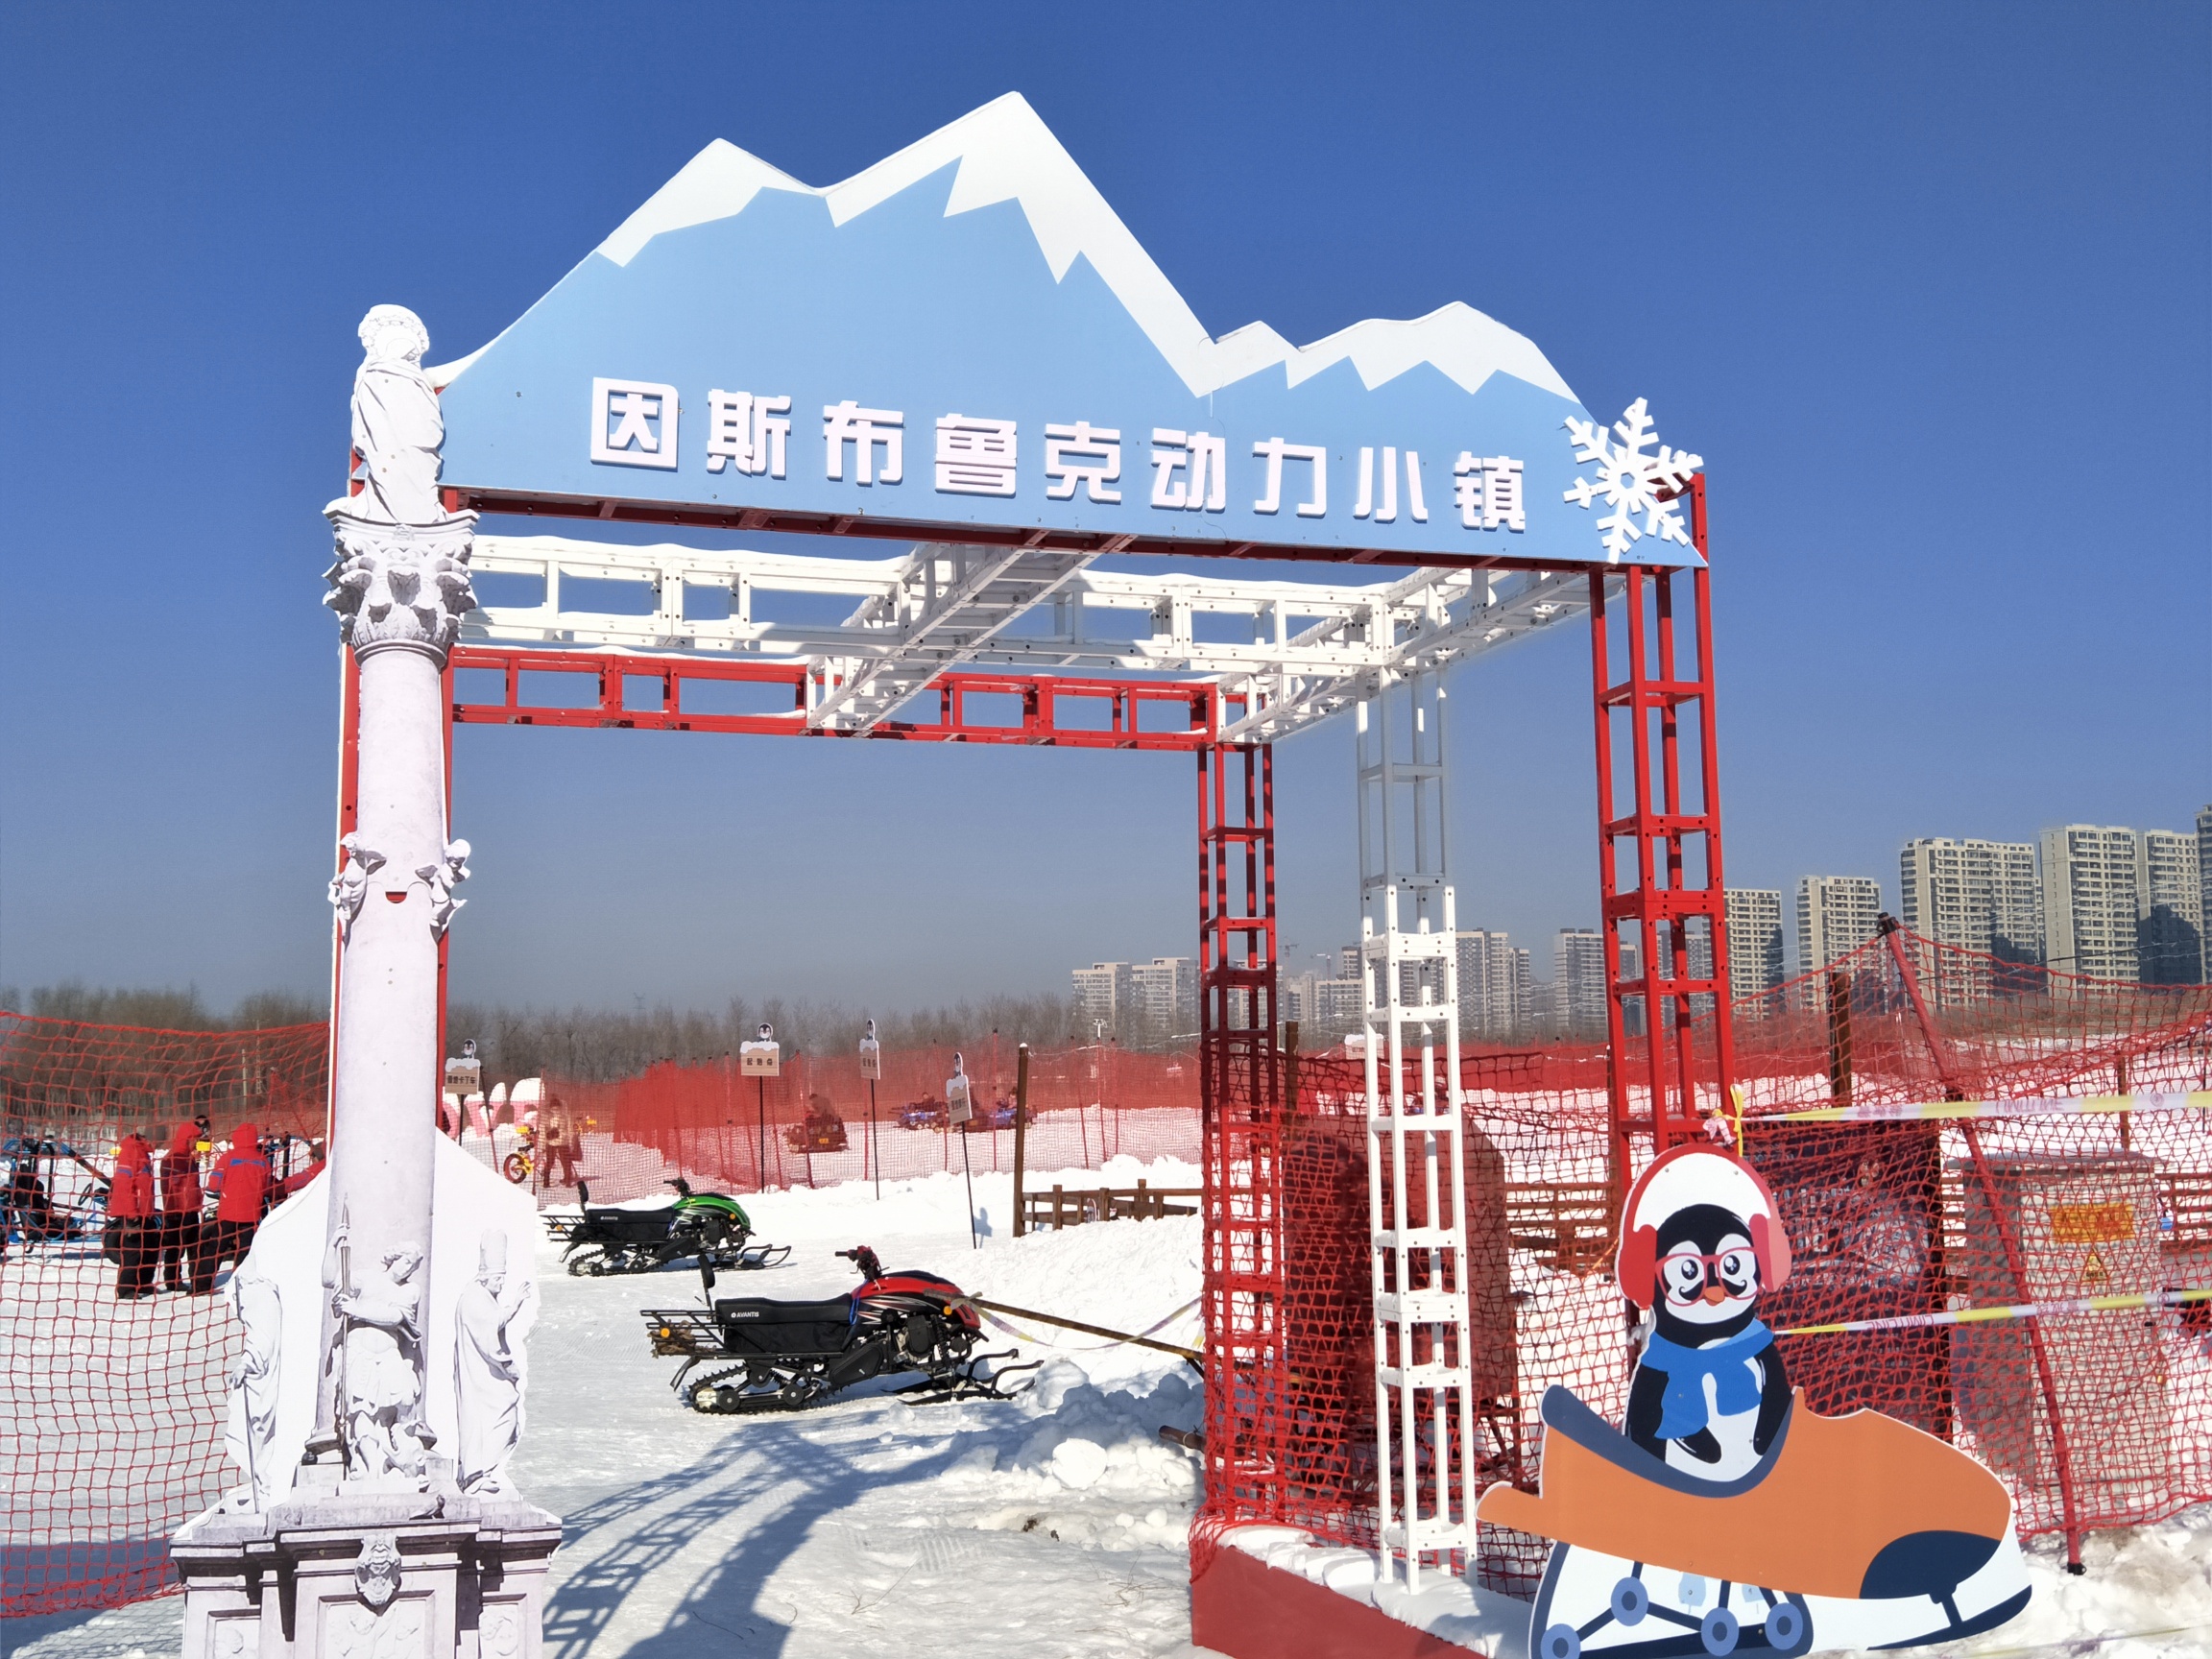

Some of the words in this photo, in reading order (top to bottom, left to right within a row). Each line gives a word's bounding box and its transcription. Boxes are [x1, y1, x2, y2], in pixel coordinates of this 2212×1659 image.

[591, 377, 1526, 531] 因斯布鲁克动力小镇
